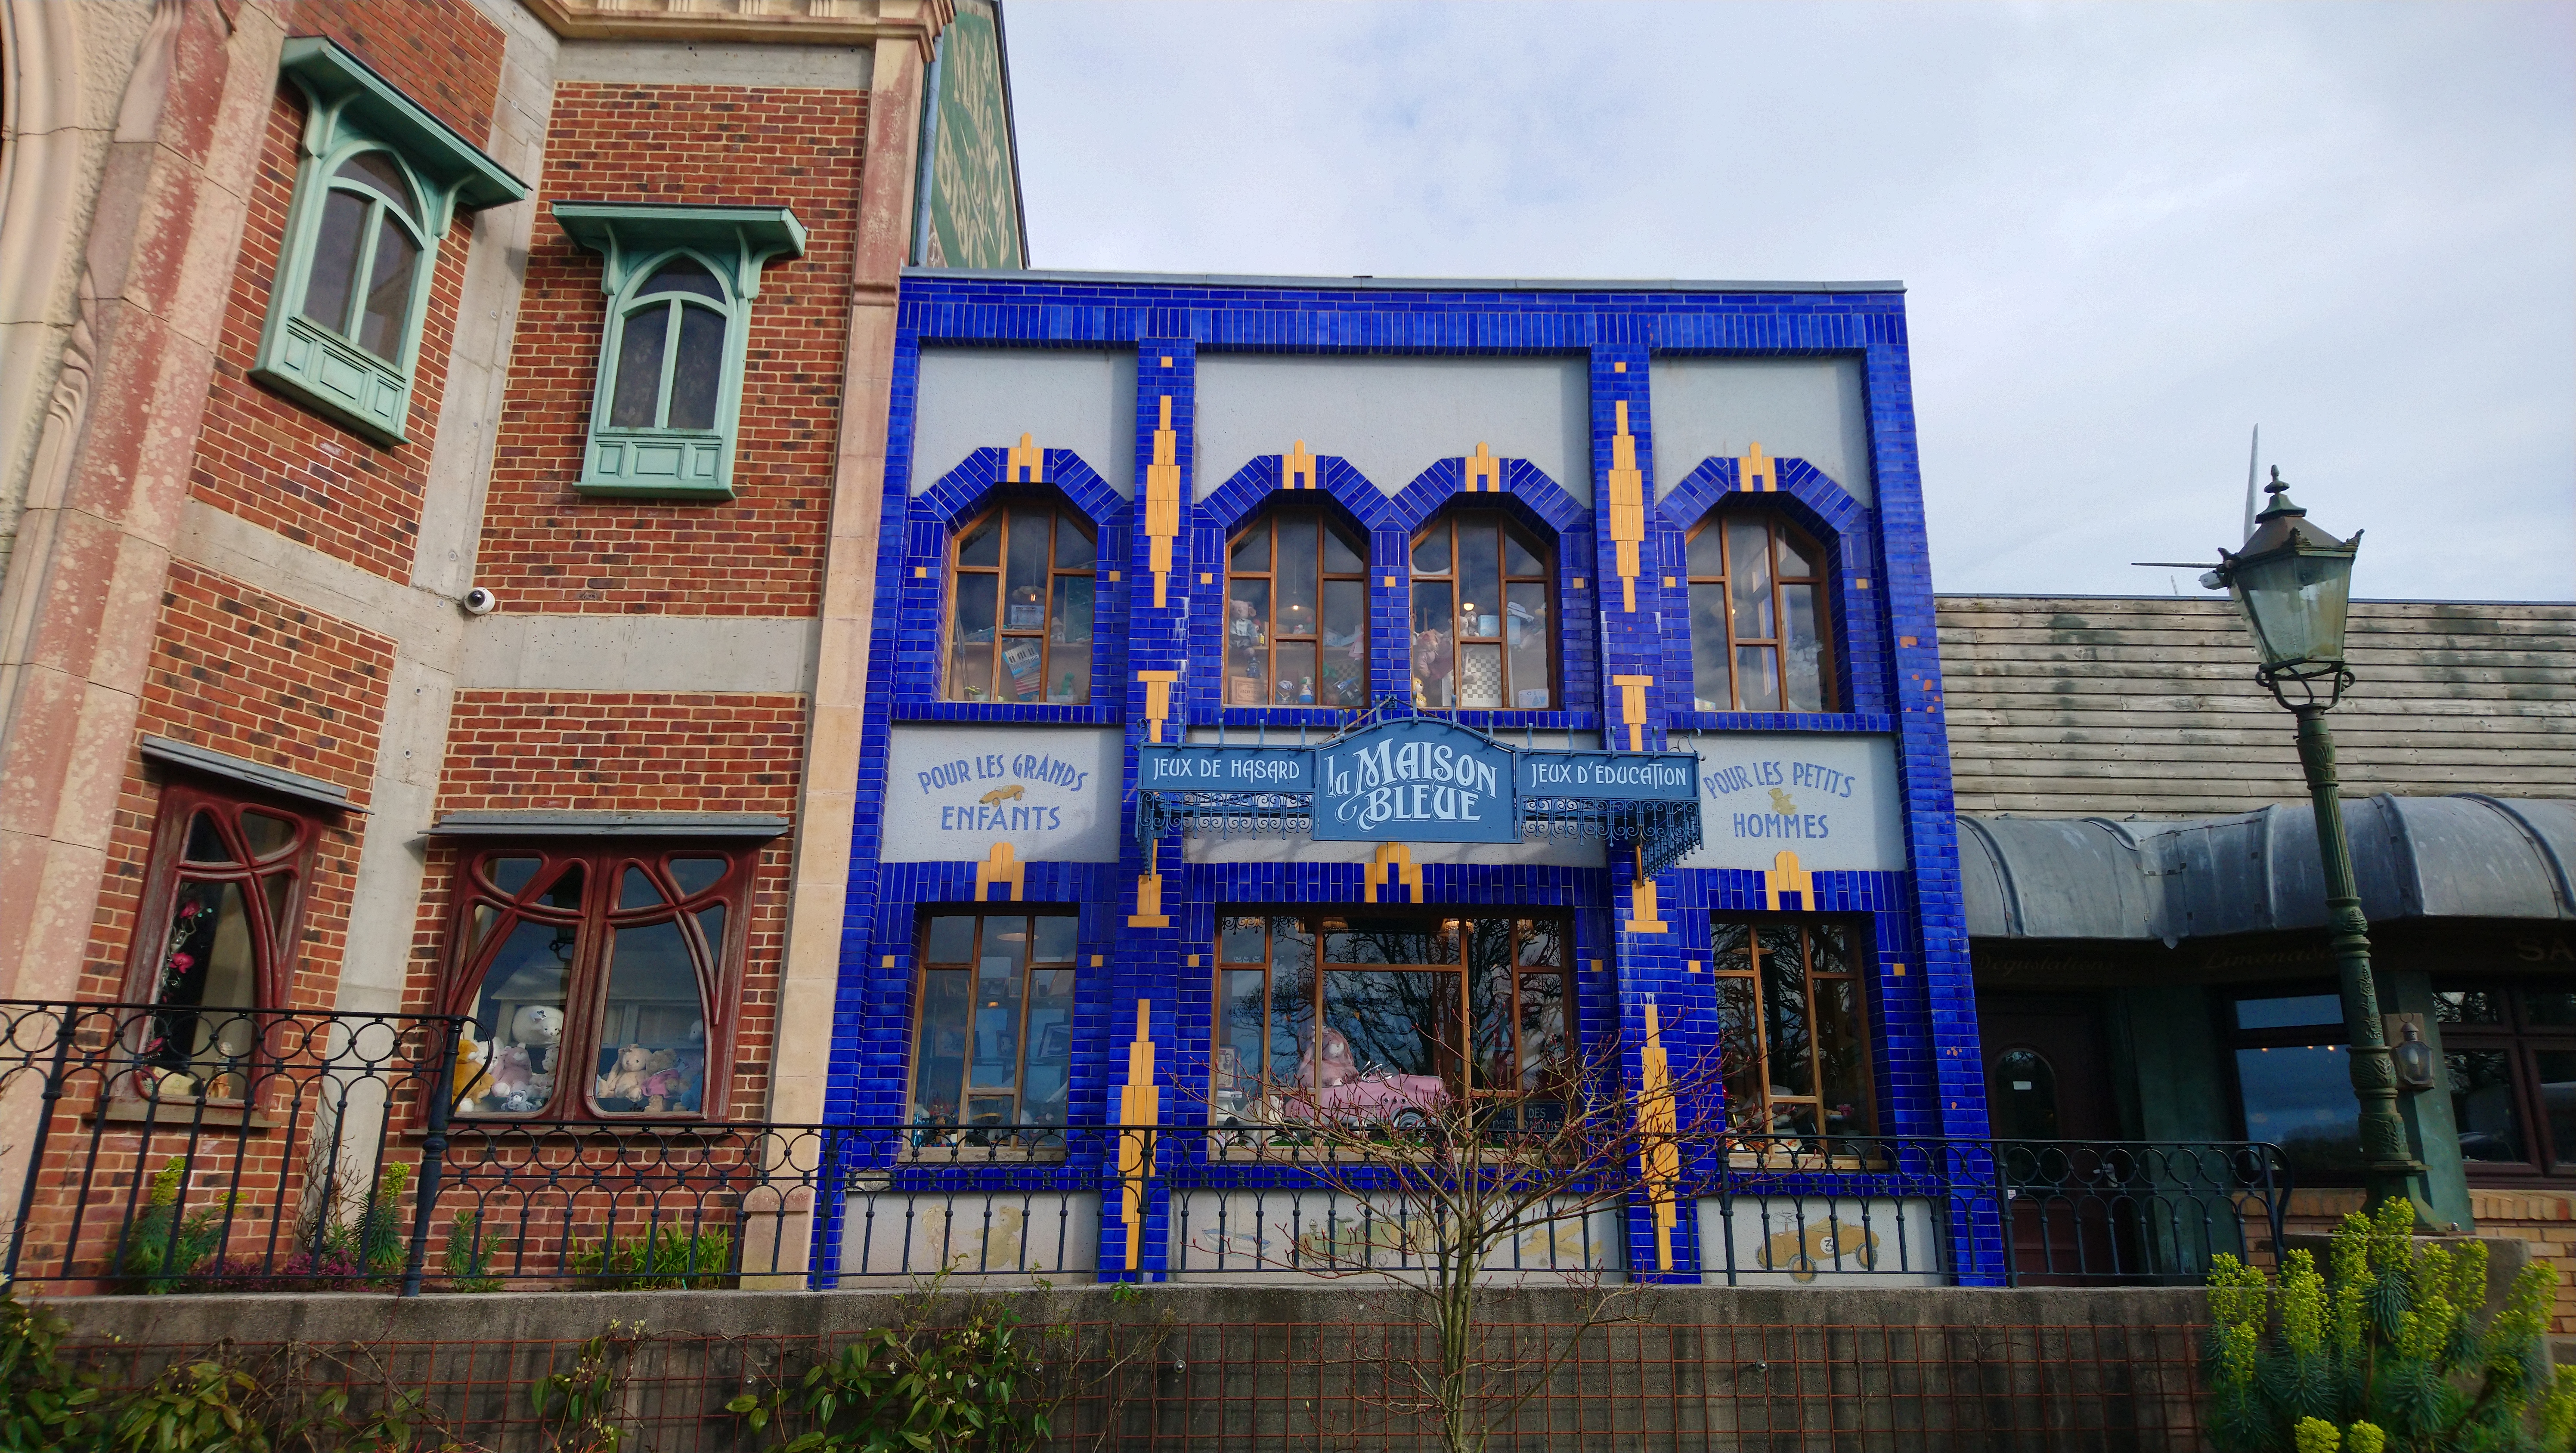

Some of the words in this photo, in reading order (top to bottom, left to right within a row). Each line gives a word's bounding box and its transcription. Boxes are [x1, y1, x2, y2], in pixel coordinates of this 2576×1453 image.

[950, 21, 1009, 269] MAISON
[935, 100, 988, 269] BISC
[917, 760, 972, 795] POUR
[976, 754, 1005, 779] LES
[1012, 753, 1089, 791] GRANDS
[1153, 758, 1193, 780] JEUX
[1201, 759, 1221, 777] DE
[1231, 759, 1300, 784] HASARD
[1324, 754, 1351, 799] la
[1335, 738, 1498, 823] MAISON
[1532, 764, 1572, 788] JEUX
[1703, 766, 1753, 799] POUR
[1752, 761, 1783, 786] LES
[1793, 762, 1855, 798] PETITS
[941, 805, 1060, 831] ENFANTS
[1357, 784, 1481, 832] BLEUE
[1733, 813, 1829, 838] HOMMES
[1529, 1108, 1546, 1118] DES
[1824, 1239, 1833, 1252] 3
